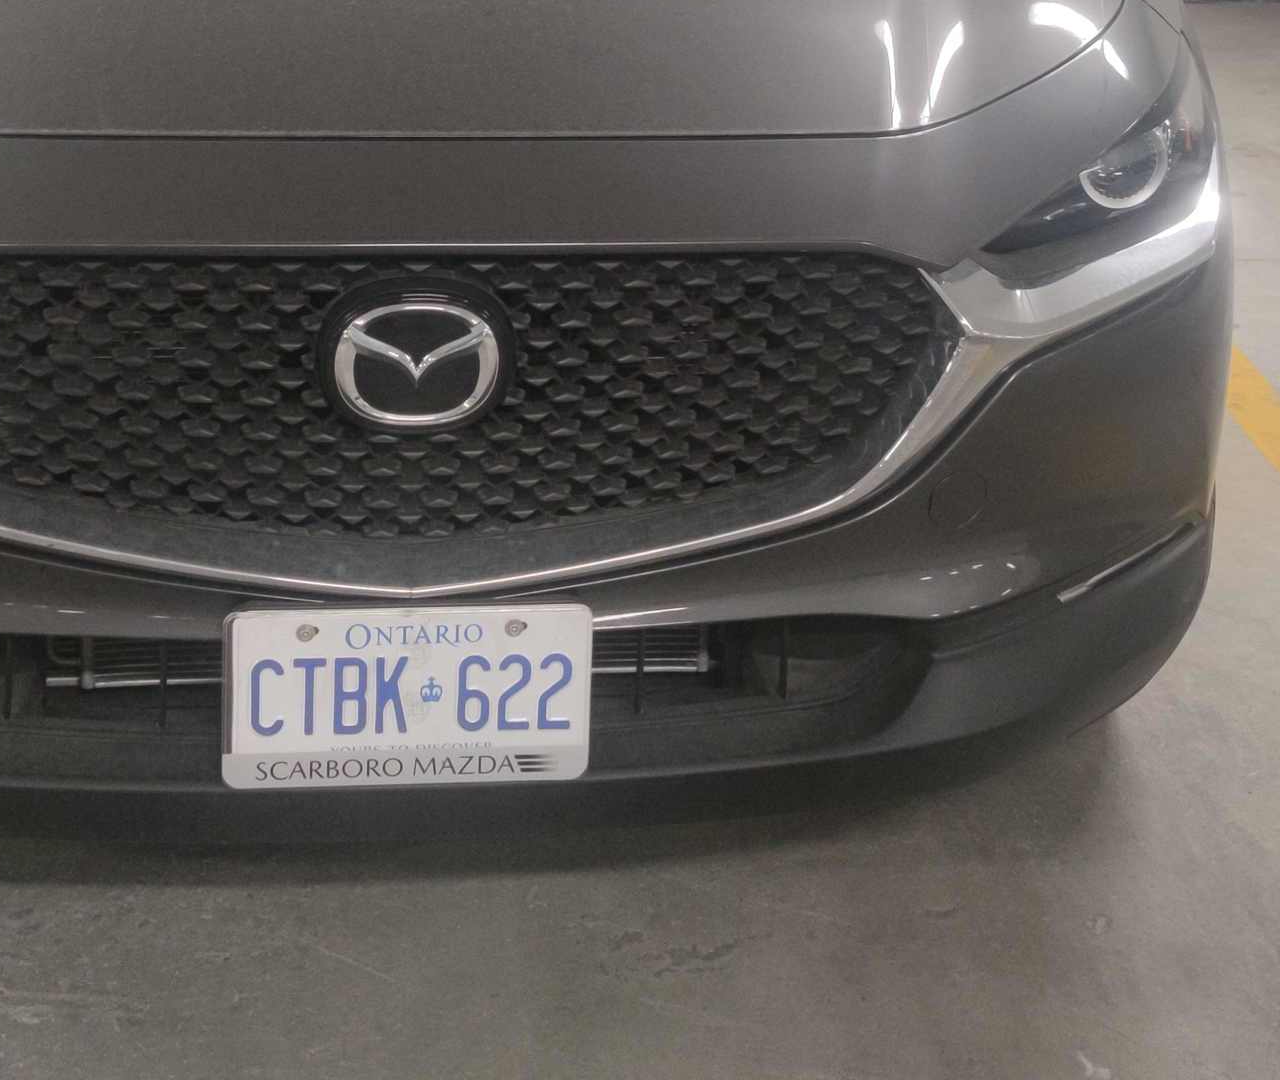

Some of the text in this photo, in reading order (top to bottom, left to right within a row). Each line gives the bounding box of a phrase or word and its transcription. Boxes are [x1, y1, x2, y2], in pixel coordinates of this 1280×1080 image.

[345, 623, 483, 649] ONTARIO
[250, 653, 573, 736] CTBK 622
[255, 754, 516, 781] SCARBORO MAZDA
